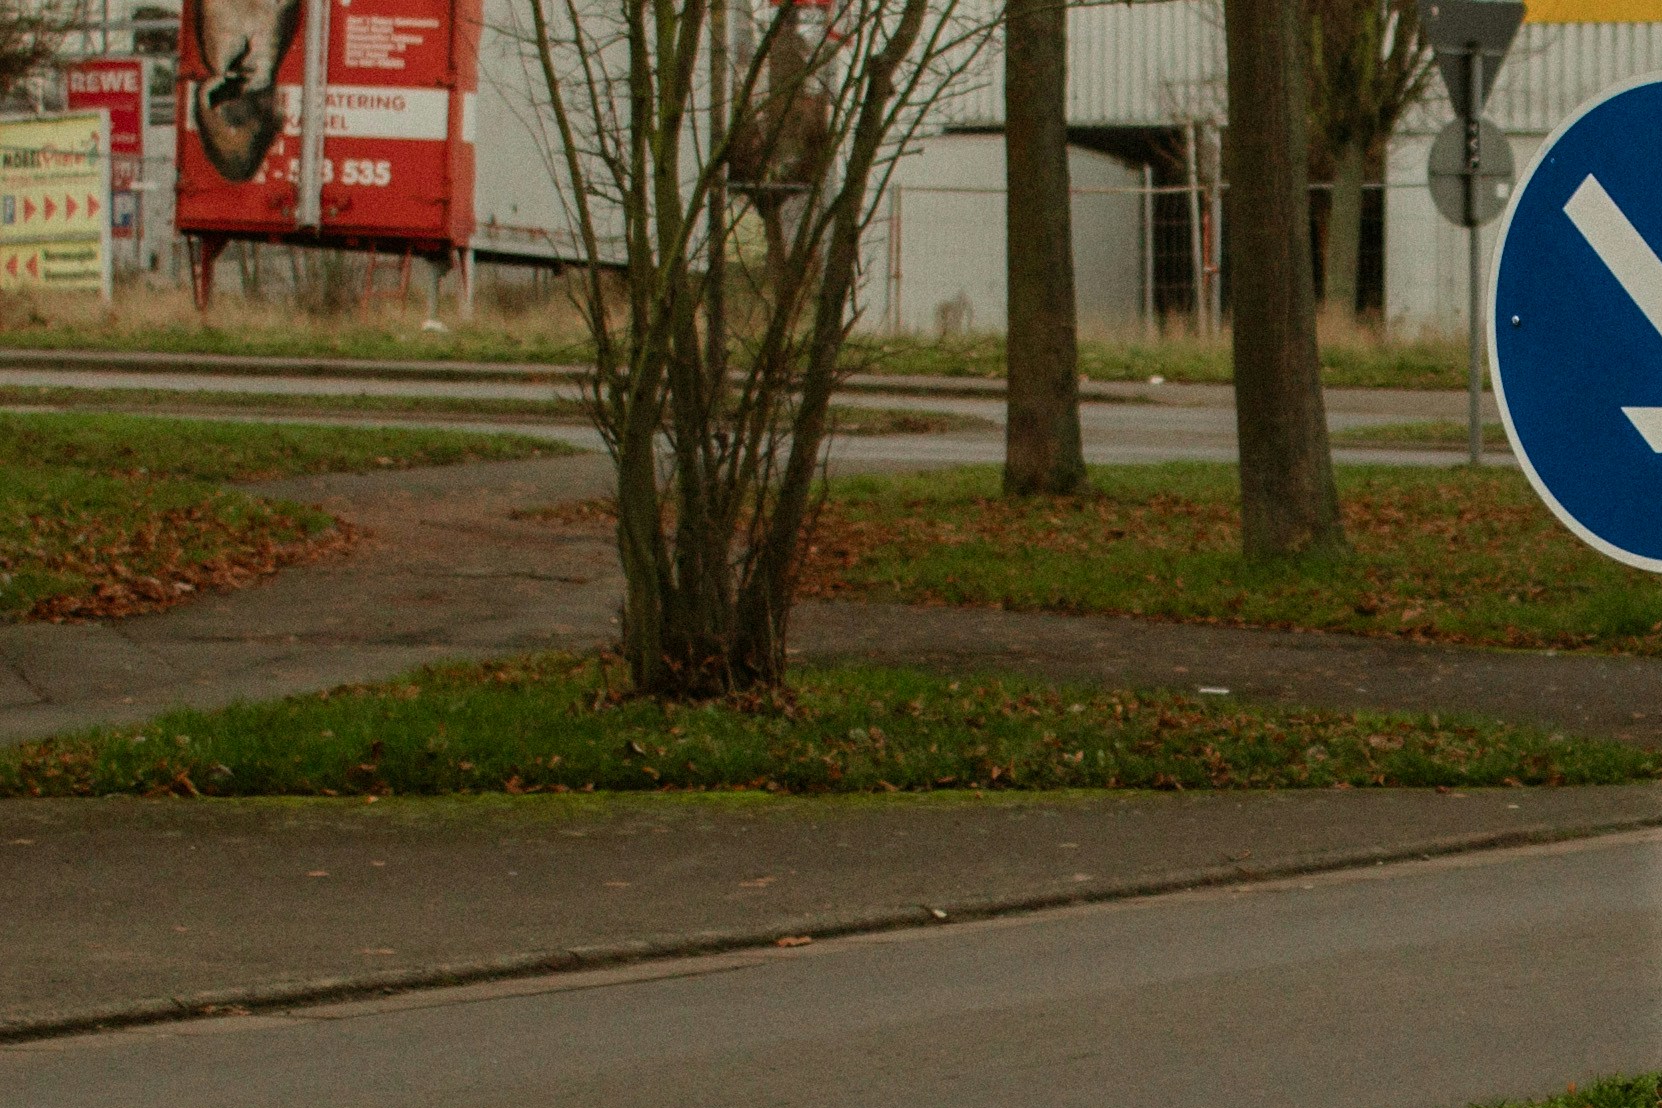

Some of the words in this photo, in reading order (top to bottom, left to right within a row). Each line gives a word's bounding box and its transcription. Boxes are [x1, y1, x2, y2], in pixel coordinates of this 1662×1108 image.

[69, 70, 139, 93] REWE
[323, 95, 406, 111] ATERING
[341, 159, 391, 187] 535
